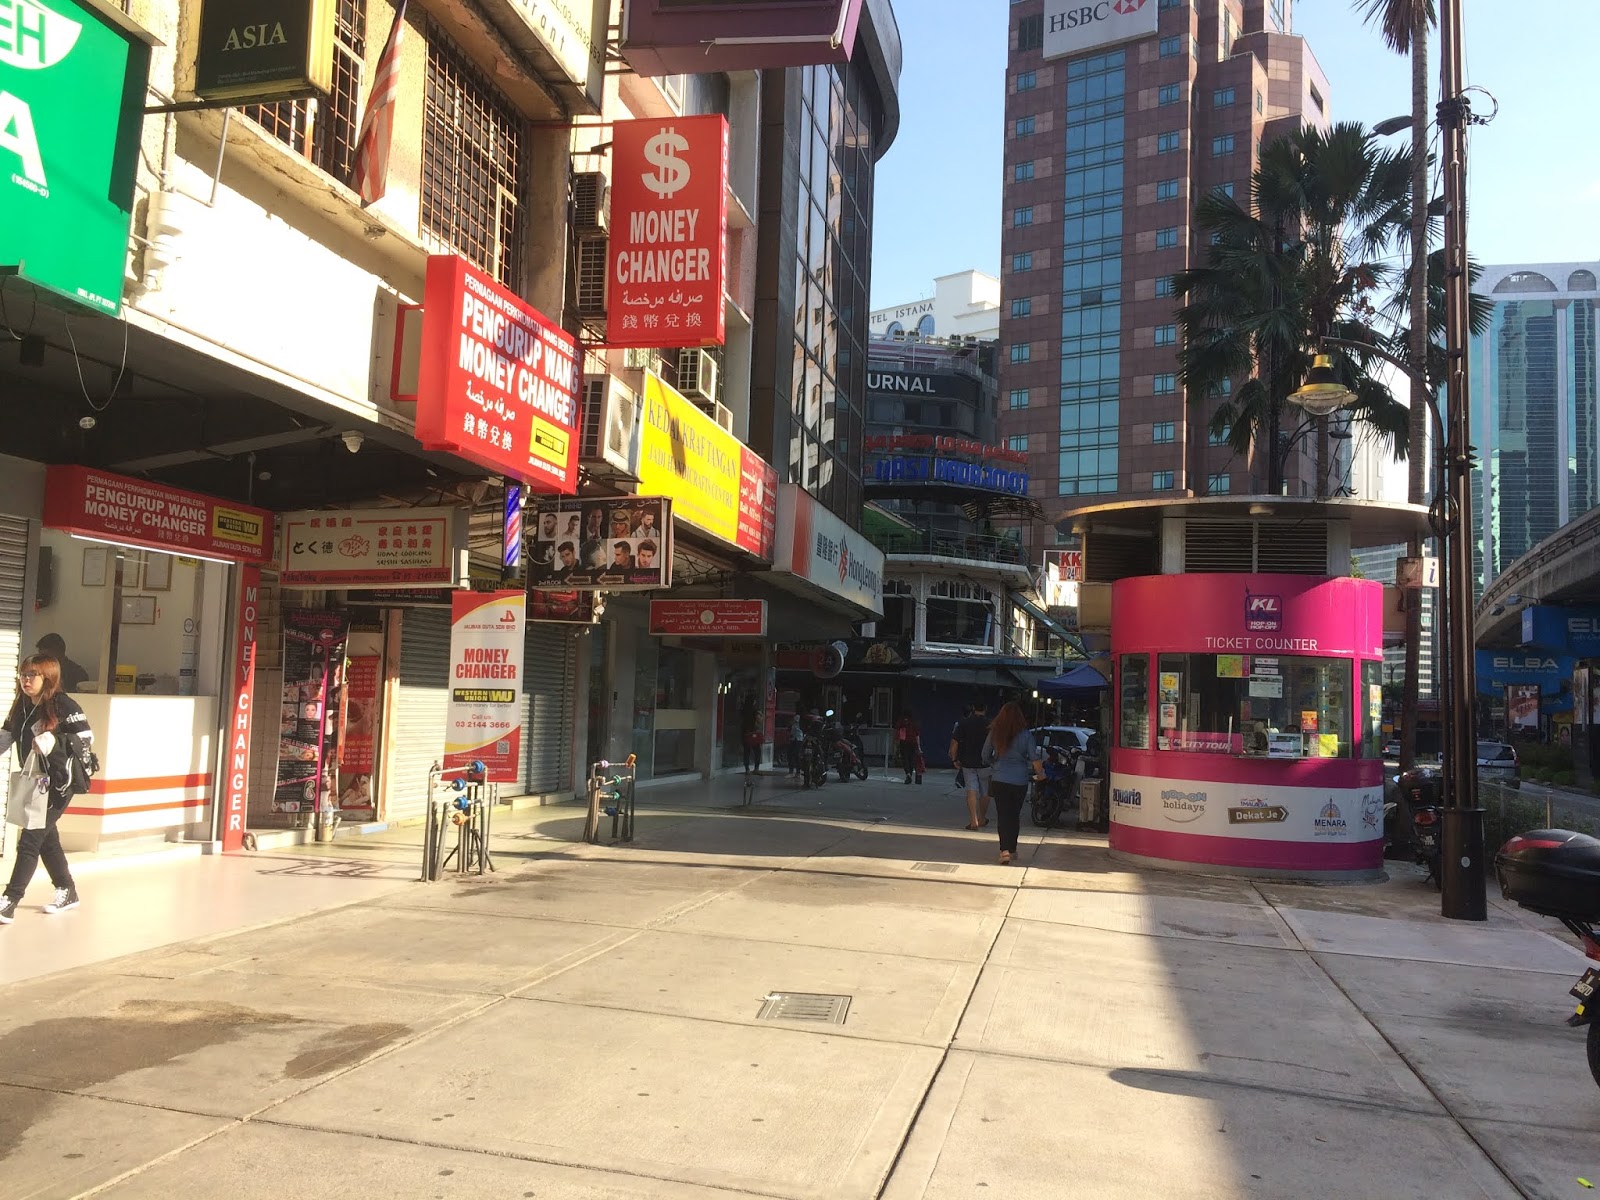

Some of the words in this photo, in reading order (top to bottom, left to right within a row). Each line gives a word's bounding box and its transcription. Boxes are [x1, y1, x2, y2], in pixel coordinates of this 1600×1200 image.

[1049, 1, 1110, 34] HSBC
[222, 21, 288, 52] ASIA
[630, 208, 700, 244] MONEY
[616, 248, 711, 284] CHANGER
[719, 215, 728, 328] CHANGER
[870, 313, 888, 325] TEL
[895, 302, 935, 319] ISTANA
[461, 291, 543, 370] PENGURUP
[544, 346, 580, 395] WANG
[458, 333, 518, 395] MONEY
[517, 367, 577, 430] CHANGER
[867, 373, 936, 394] URNAL
[648, 398, 680, 442] KEDAI
[682, 422, 706, 458] KRAF
[706, 441, 737, 480] TANGAN
[87, 474, 124, 489] PERNIAGAAN
[164, 492, 180, 502] WANG
[86, 484, 165, 513] PENGURUP
[168, 502, 207, 523] WANG
[84, 500, 139, 523] MONEY
[141, 512, 206, 537] CHANGER
[1060, 552, 1082, 567] KK
[1250, 598, 1278, 611] KL
[241, 585, 258, 682] MONEY
[1204, 636, 1252, 650] TICKET
[1255, 637, 1318, 651] COUNTER
[464, 648, 510, 664] MONEY
[1493, 657, 1560, 669] ELBA
[455, 663, 517, 680] CHANGER
[489, 690, 513, 702] WU
[1182, 740, 1205, 749] CITY
[1206, 741, 1232, 750] TOUR
[229, 692, 249, 832] CHANGER
[1112, 788, 1142, 807] aquaria
[1161, 789, 1207, 803] HOP-ON
[1163, 800, 1205, 812] holidays
[1236, 811, 1264, 820] Dekat
[1266, 810, 1278, 819] Je
[1314, 819, 1347, 827] MENARA
